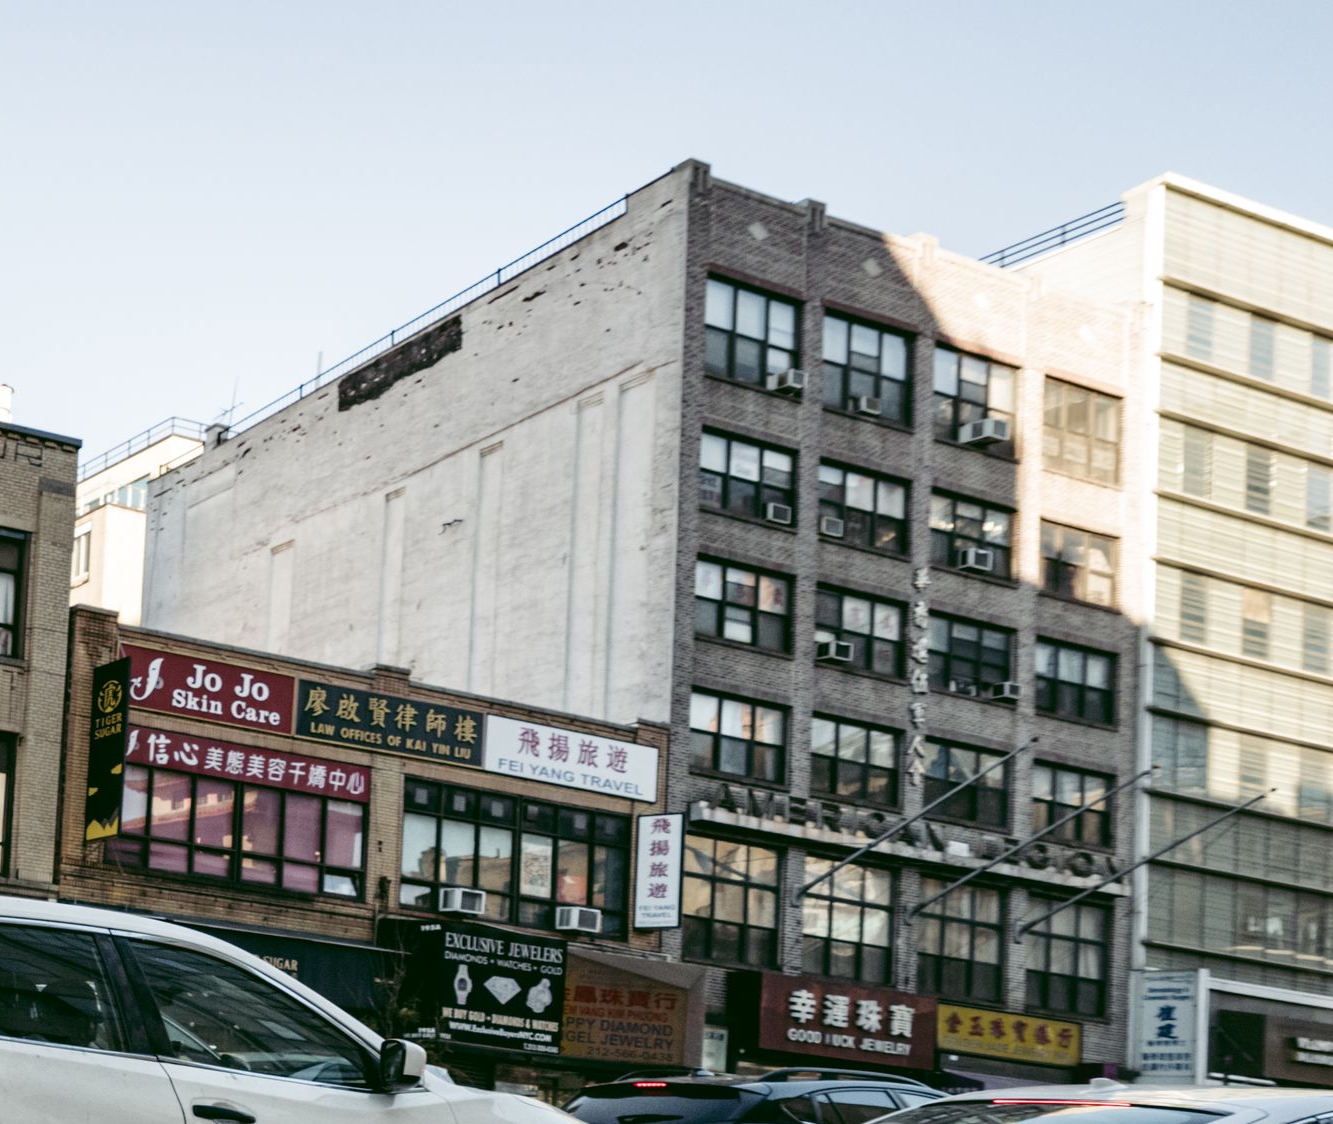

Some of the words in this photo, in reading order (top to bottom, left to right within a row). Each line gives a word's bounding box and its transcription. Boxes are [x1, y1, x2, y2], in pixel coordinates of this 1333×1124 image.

[185, 664, 223, 692] Jo
[234, 673, 270, 701] Jo
[96, 712, 122, 728] TIGER
[171, 689, 223, 715] Skin
[230, 700, 281, 726] Care
[95, 723, 122, 740] SUGAR
[310, 722, 335, 736] LAW
[340, 727, 382, 744] OFFICES
[386, 735, 402, 747] OF
[406, 738, 426, 751] KAI
[431, 742, 450, 755] YIN
[454, 746, 471, 759] LIU
[517, 727, 628, 774] 飛揚旅遊
[498, 757, 524, 773] FEI
[528, 763, 575, 782] YANG
[580, 773, 644, 796] TRAVEL
[444, 951, 488, 965] DIAMONDS
[497, 958, 532, 972] WATCHES
[540, 964, 563, 976] GOLD
[445, 932, 504, 956] EXCLUSIVE
[508, 942, 563, 964] JEWELERS
[601, 1019, 673, 1037] DIAMOND
[789, 989, 916, 1038] 幸運珠寶
[601, 1034, 675, 1050] JEWELRY
[787, 1028, 822, 1044] GOOD
[859, 1038, 912, 1056] JEWELRY
